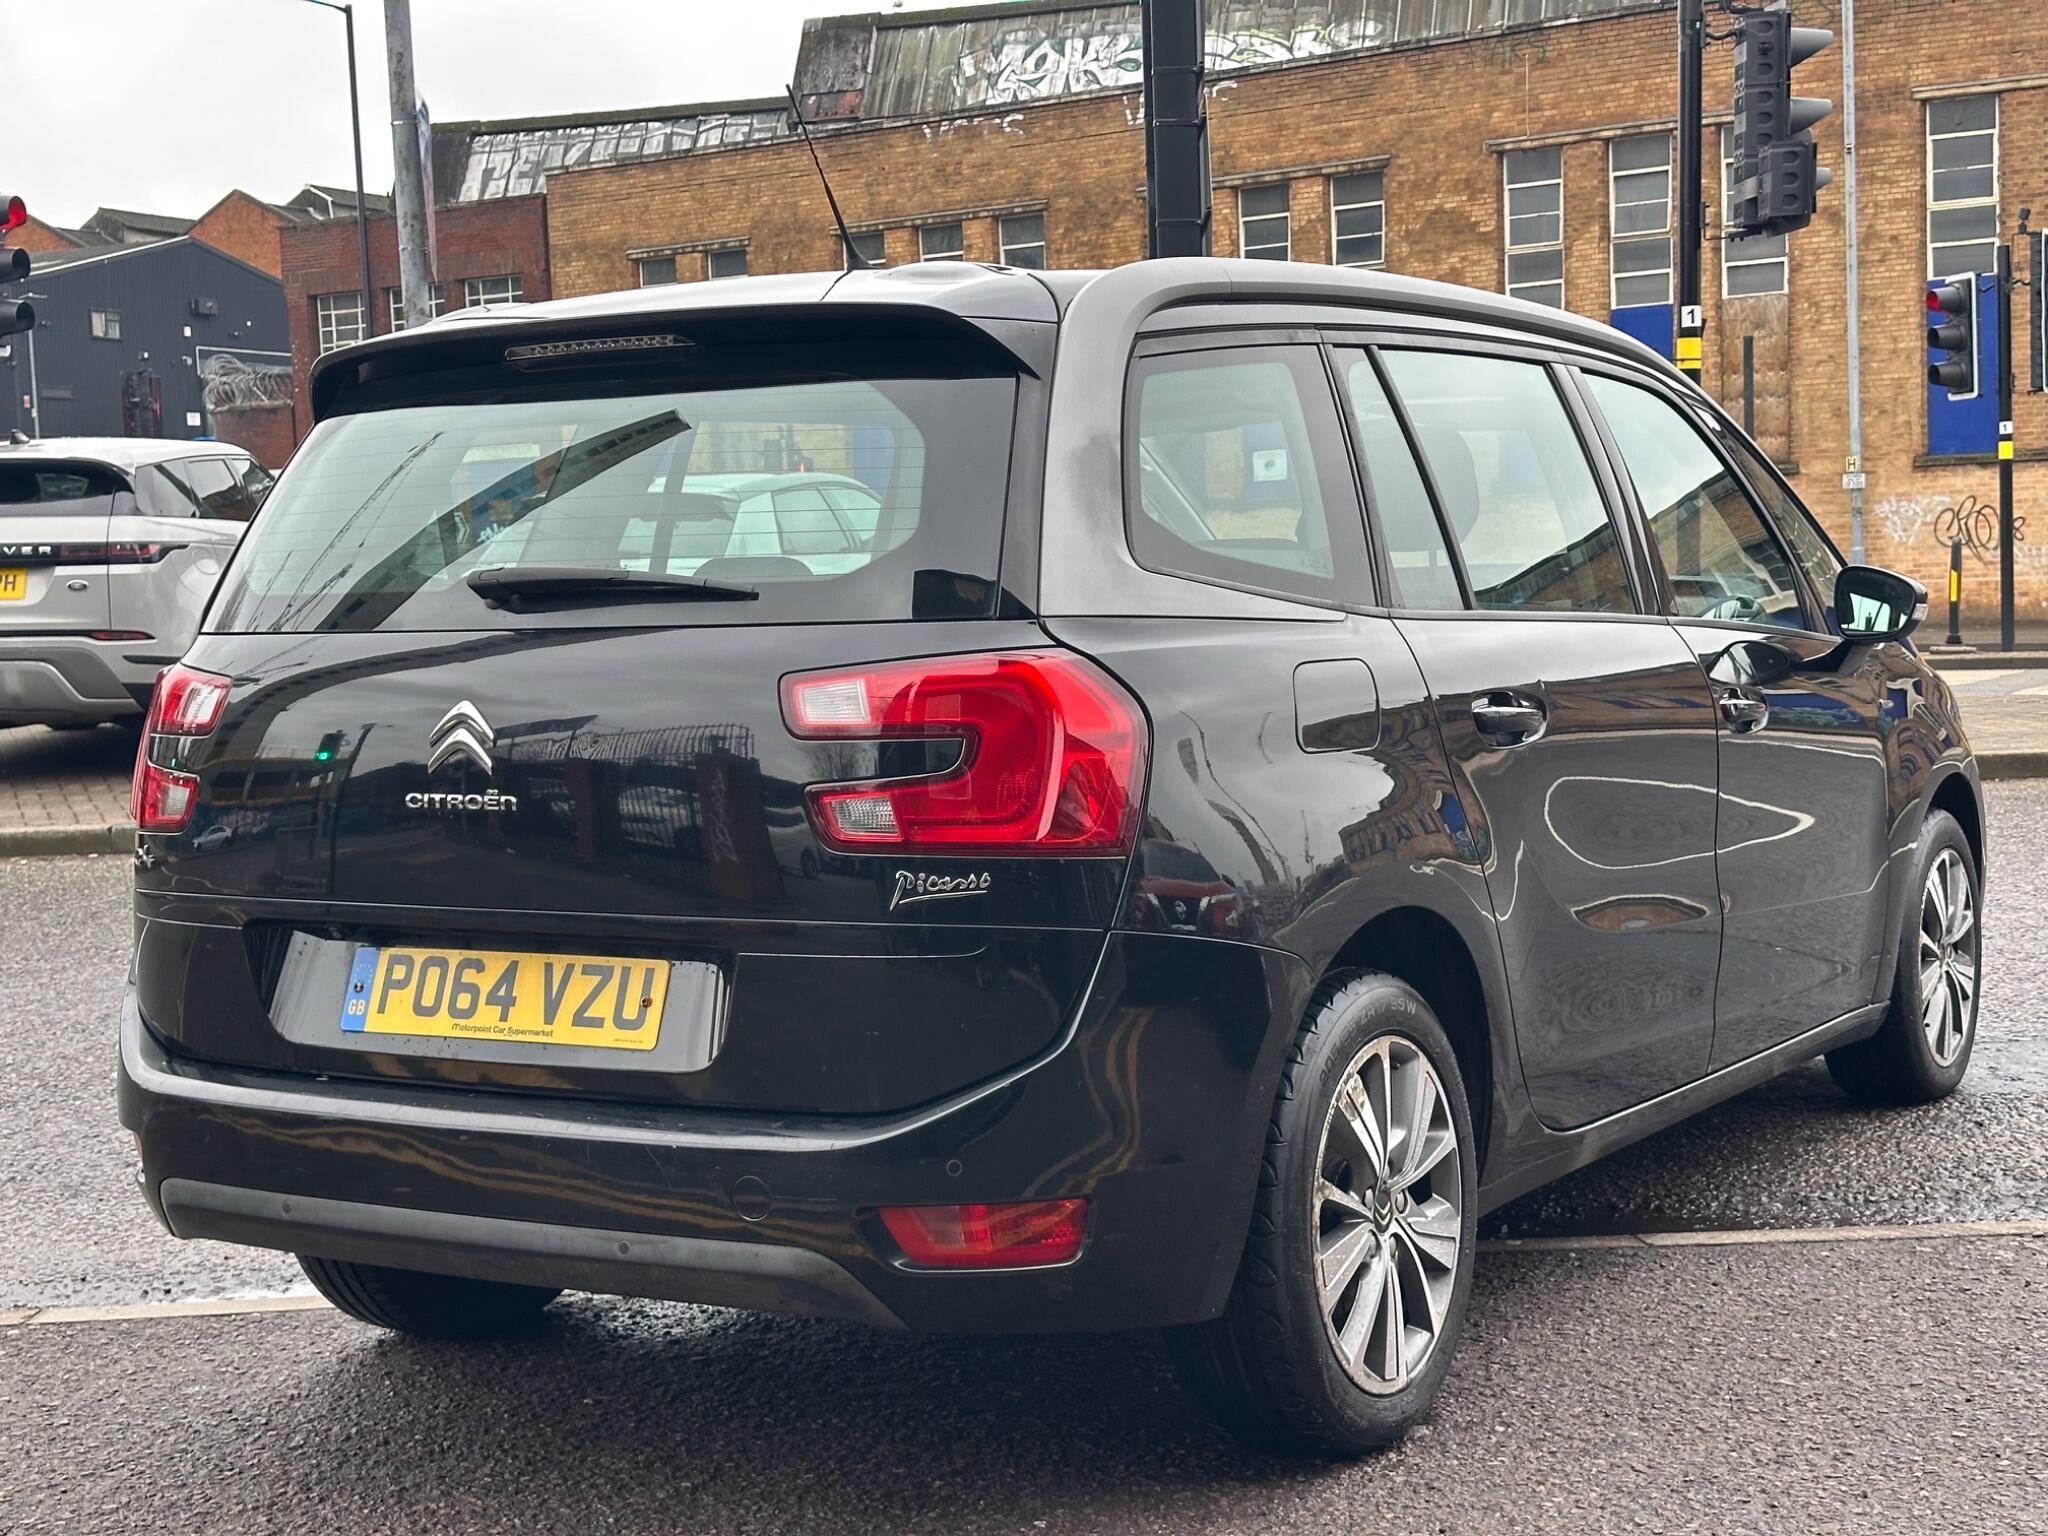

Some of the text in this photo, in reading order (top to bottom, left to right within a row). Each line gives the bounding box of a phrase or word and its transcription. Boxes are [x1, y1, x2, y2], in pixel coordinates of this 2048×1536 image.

[1687, 308, 1695, 324] 1
[1847, 457, 1856, 470] H
[0, 574, 17, 592] H
[889, 869, 992, 911] Picasso
[376, 953, 656, 1031] PO64 VZU
[347, 999, 366, 1016] GB
[451, 1023, 554, 1038] Motorpoint Car Supermarket
